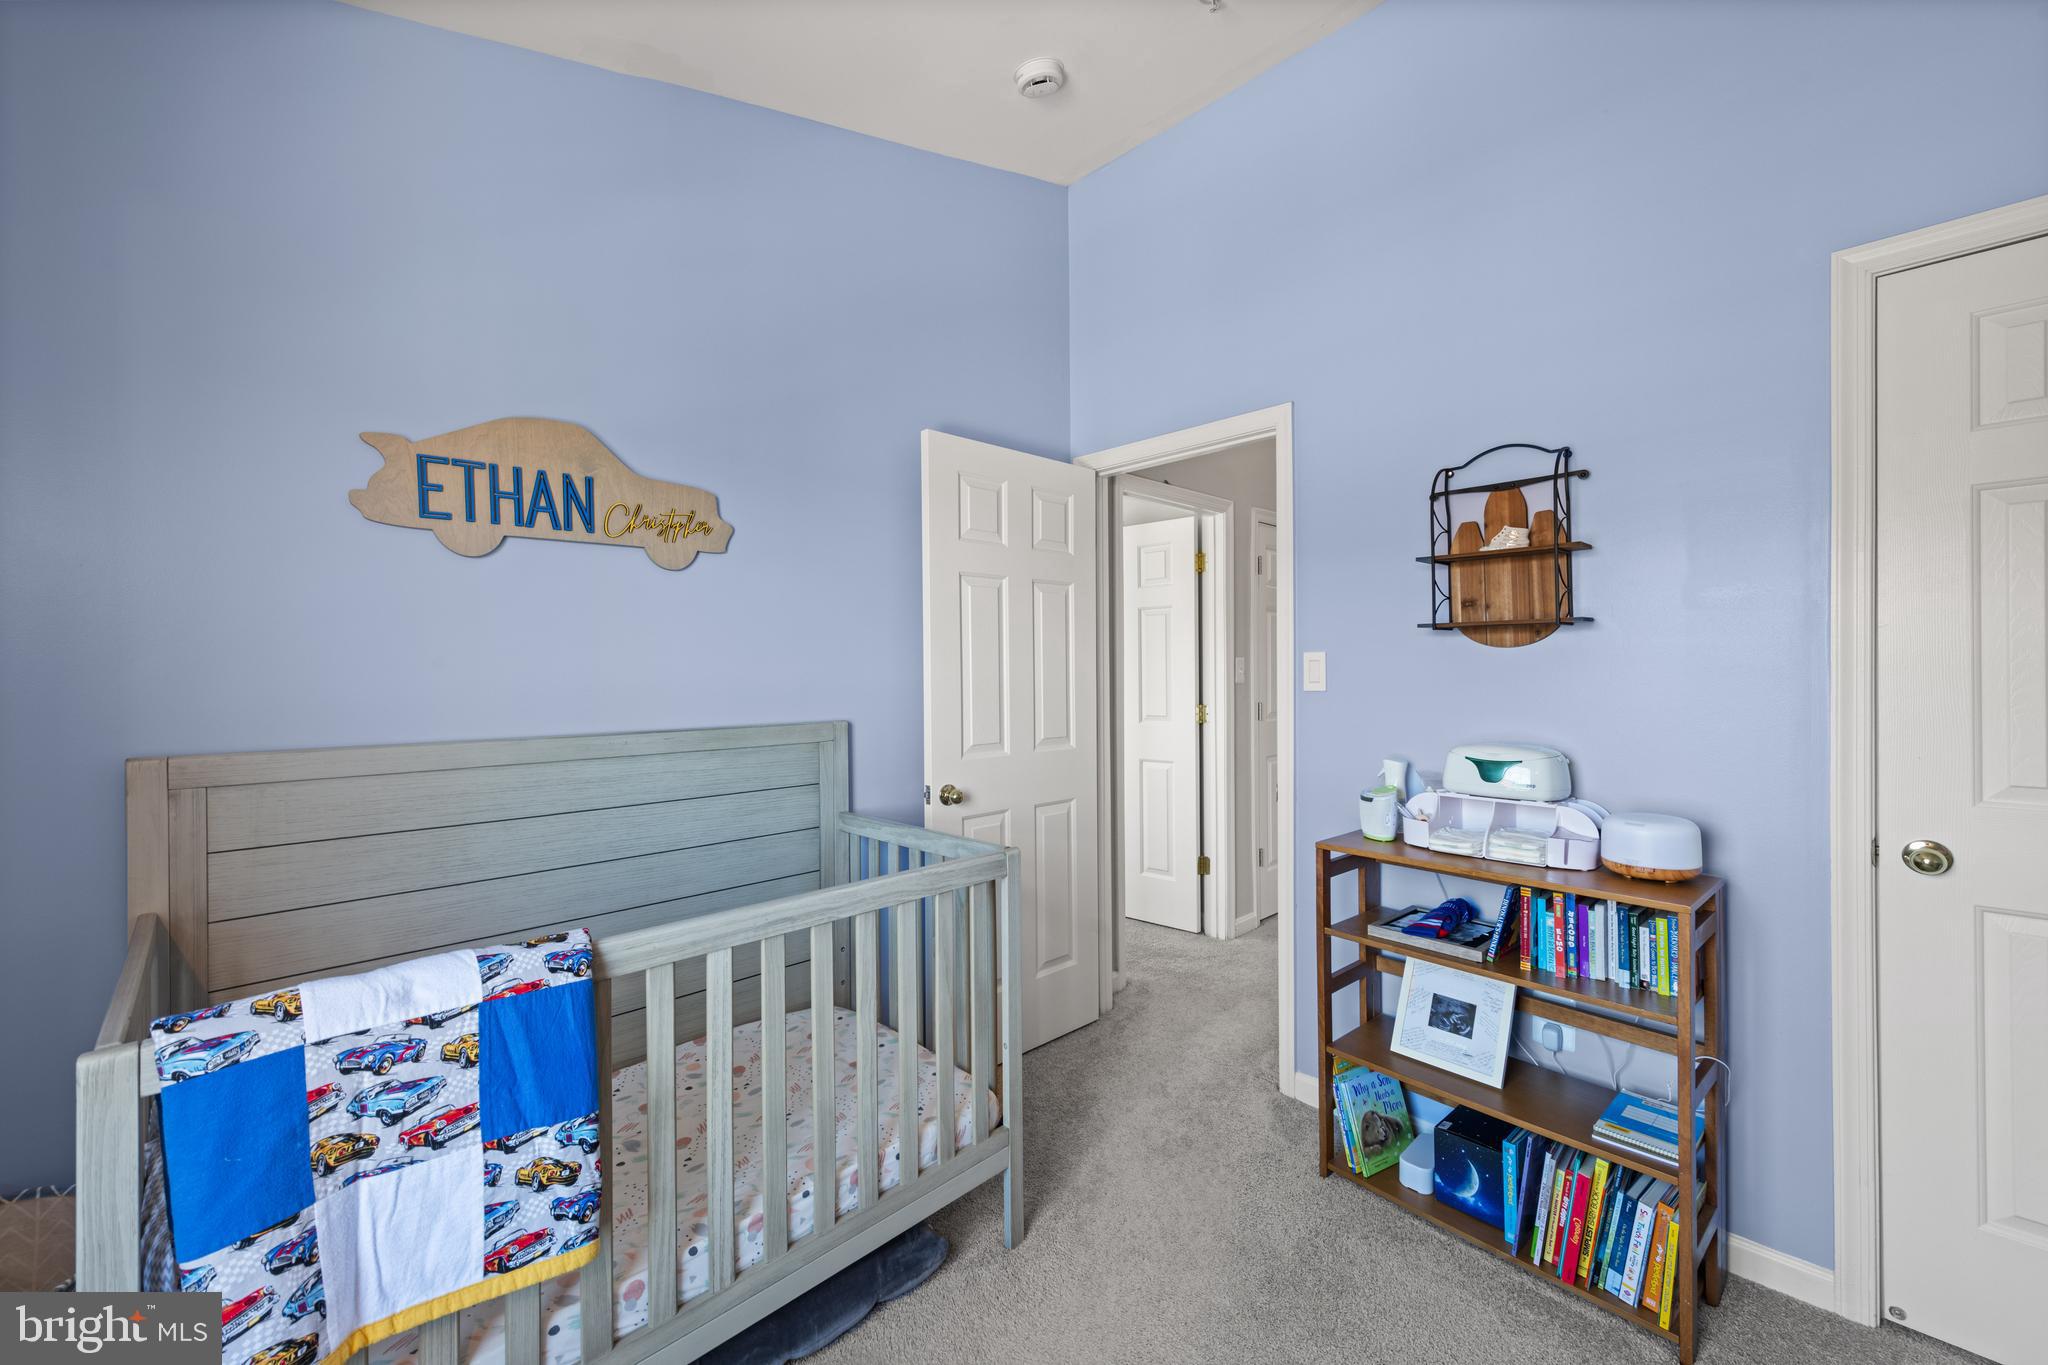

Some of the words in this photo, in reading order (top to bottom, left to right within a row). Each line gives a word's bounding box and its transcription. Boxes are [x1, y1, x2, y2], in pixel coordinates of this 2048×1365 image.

[416, 453, 596, 534] ETHAN
[1567, 910, 1575, 948] GROVER
[1352, 1083, 1370, 1097] Why
[1377, 1074, 1391, 1087] Son
[1383, 1100, 1403, 1114] Mom
[1589, 1189, 1600, 1209] BOOK
[1587, 1207, 1597, 1226] BABY
[1582, 1223, 1594, 1257] SIMPLEST
